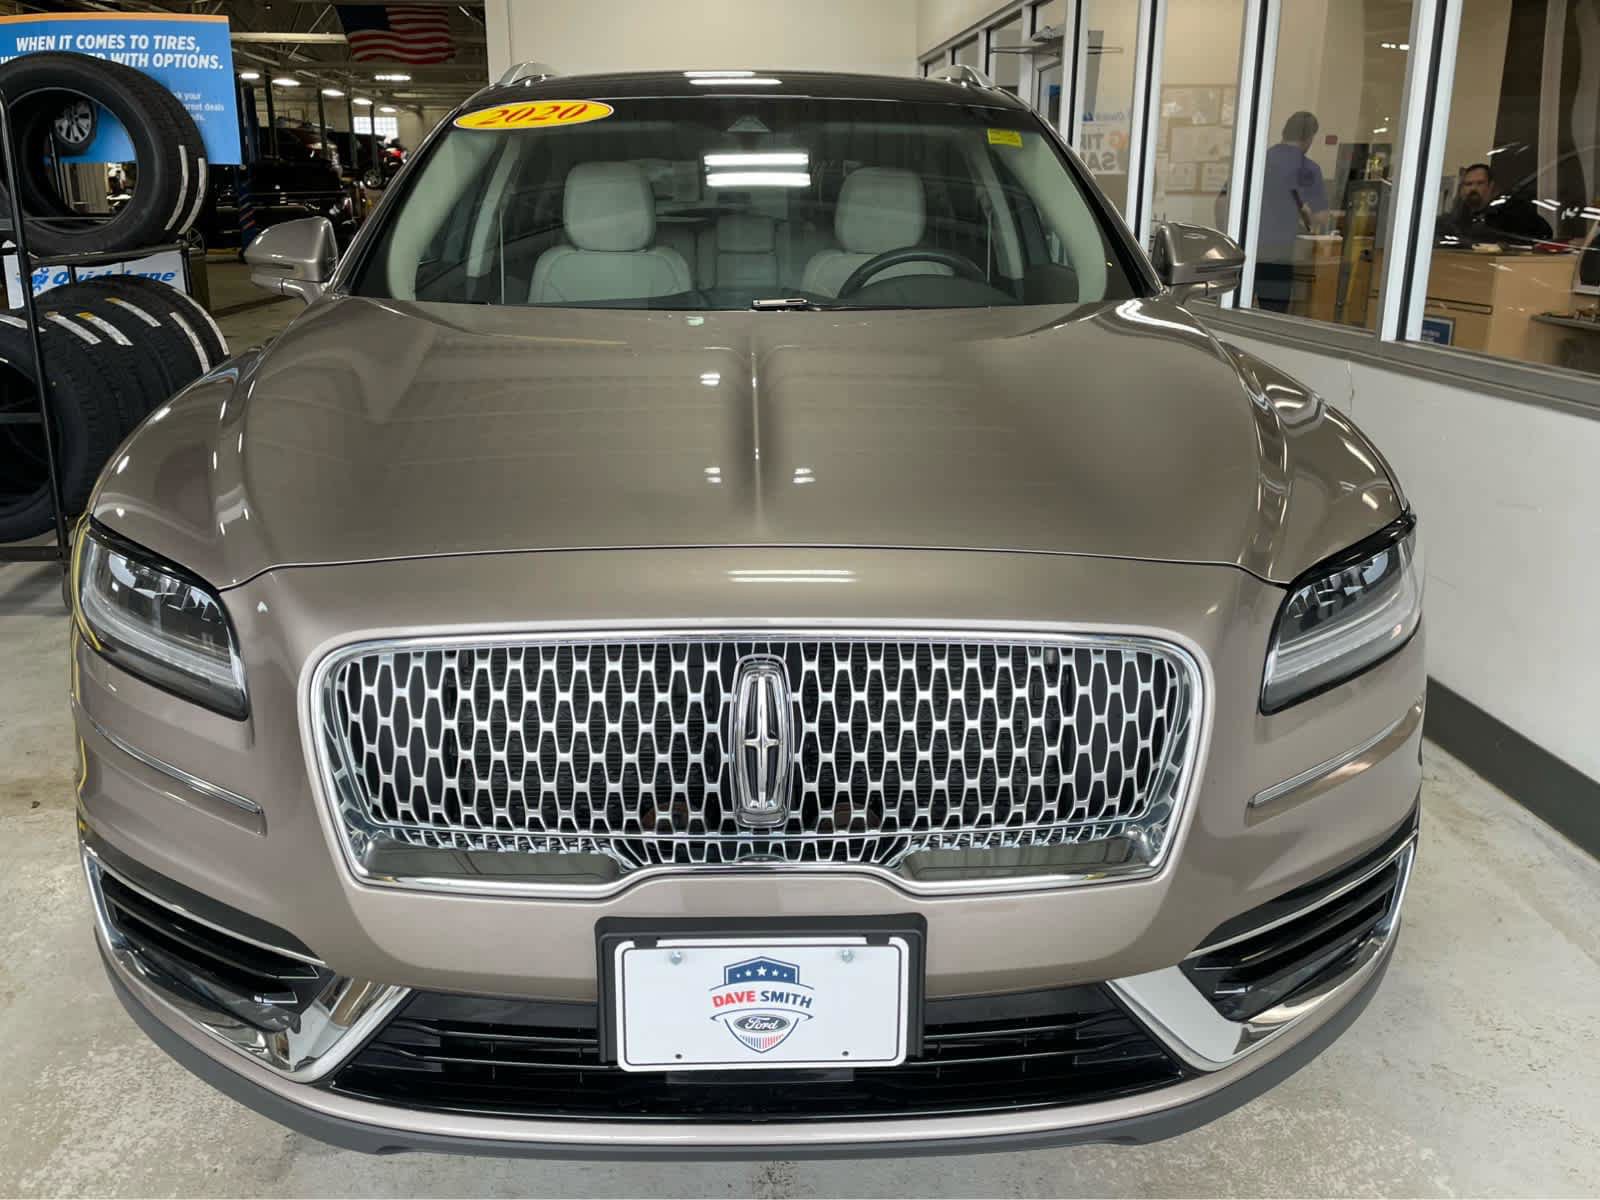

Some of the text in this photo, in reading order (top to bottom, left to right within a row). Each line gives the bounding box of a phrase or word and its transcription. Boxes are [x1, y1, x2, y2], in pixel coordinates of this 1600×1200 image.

[16, 34, 201, 53] WHEN IT COMES TO TIRES,
[110, 53, 149, 68] WITH
[152, 53, 224, 70] OPTIONS.
[476, 103, 588, 126] 2020
[712, 990, 813, 1009] DAVE SMITH
[743, 1015, 780, 1031] Ford
